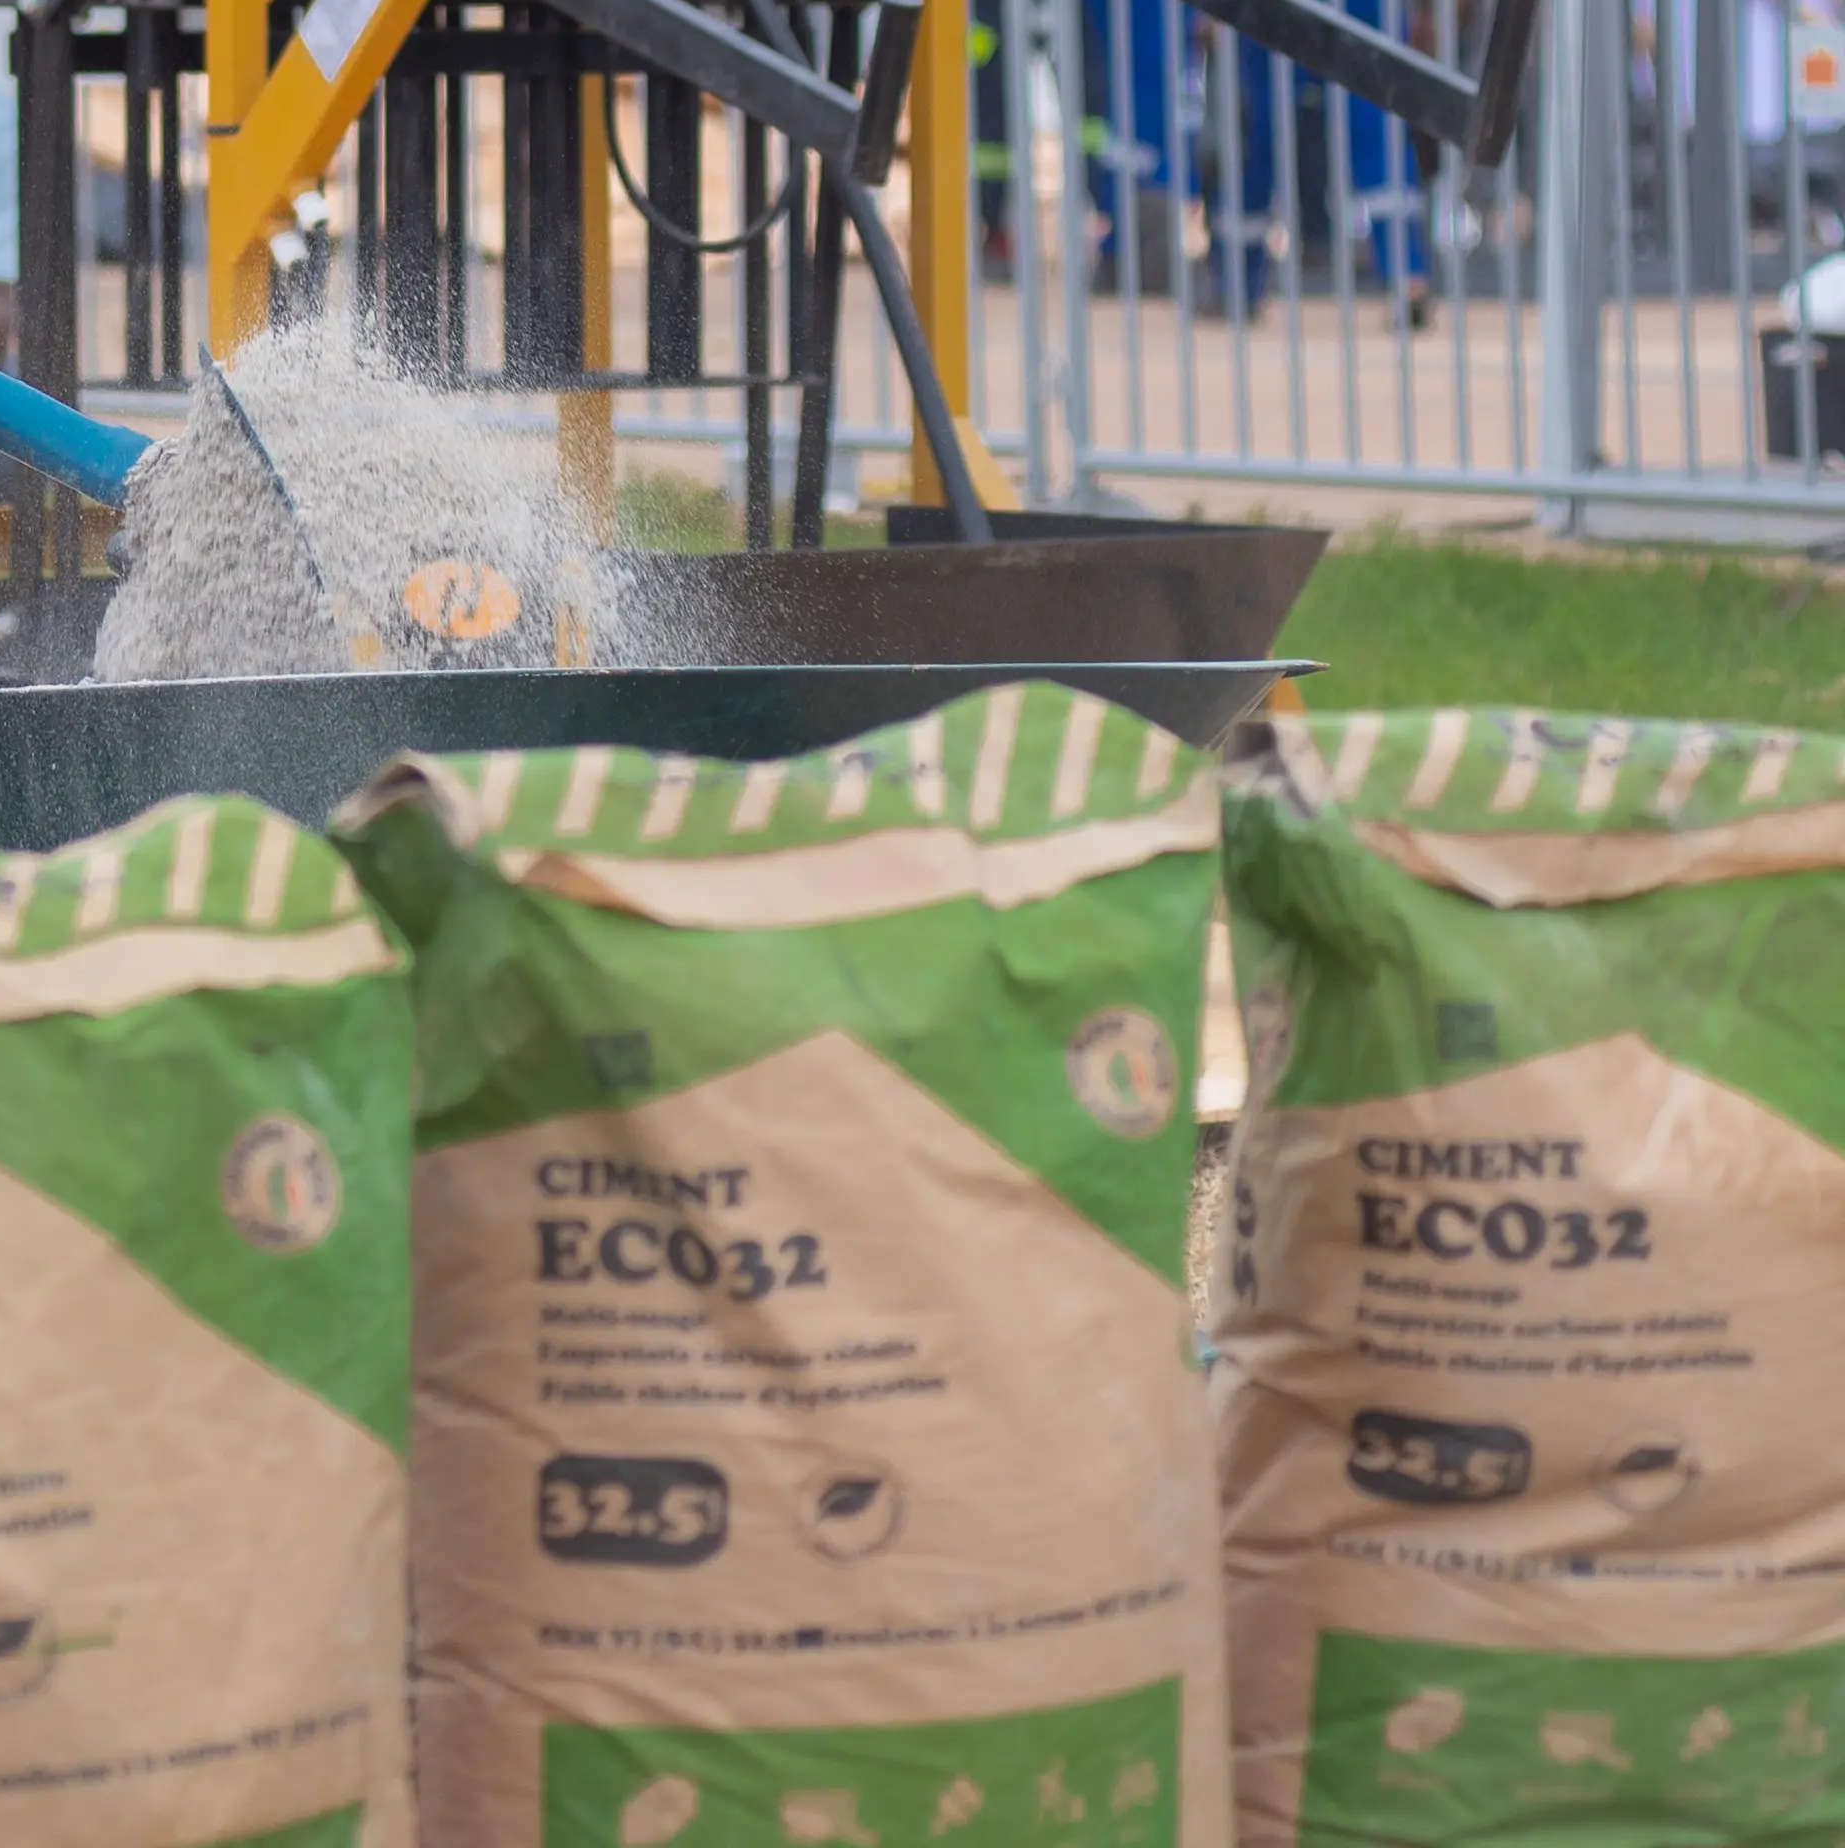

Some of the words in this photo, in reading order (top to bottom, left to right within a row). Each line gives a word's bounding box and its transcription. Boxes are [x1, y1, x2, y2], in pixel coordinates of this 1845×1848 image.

[1359, 1137, 1584, 1180] CIMENT
[537, 1219, 827, 1303] ECO32
[1359, 1191, 1652, 1270] ECO32
[543, 1480, 706, 1545] 32.5
